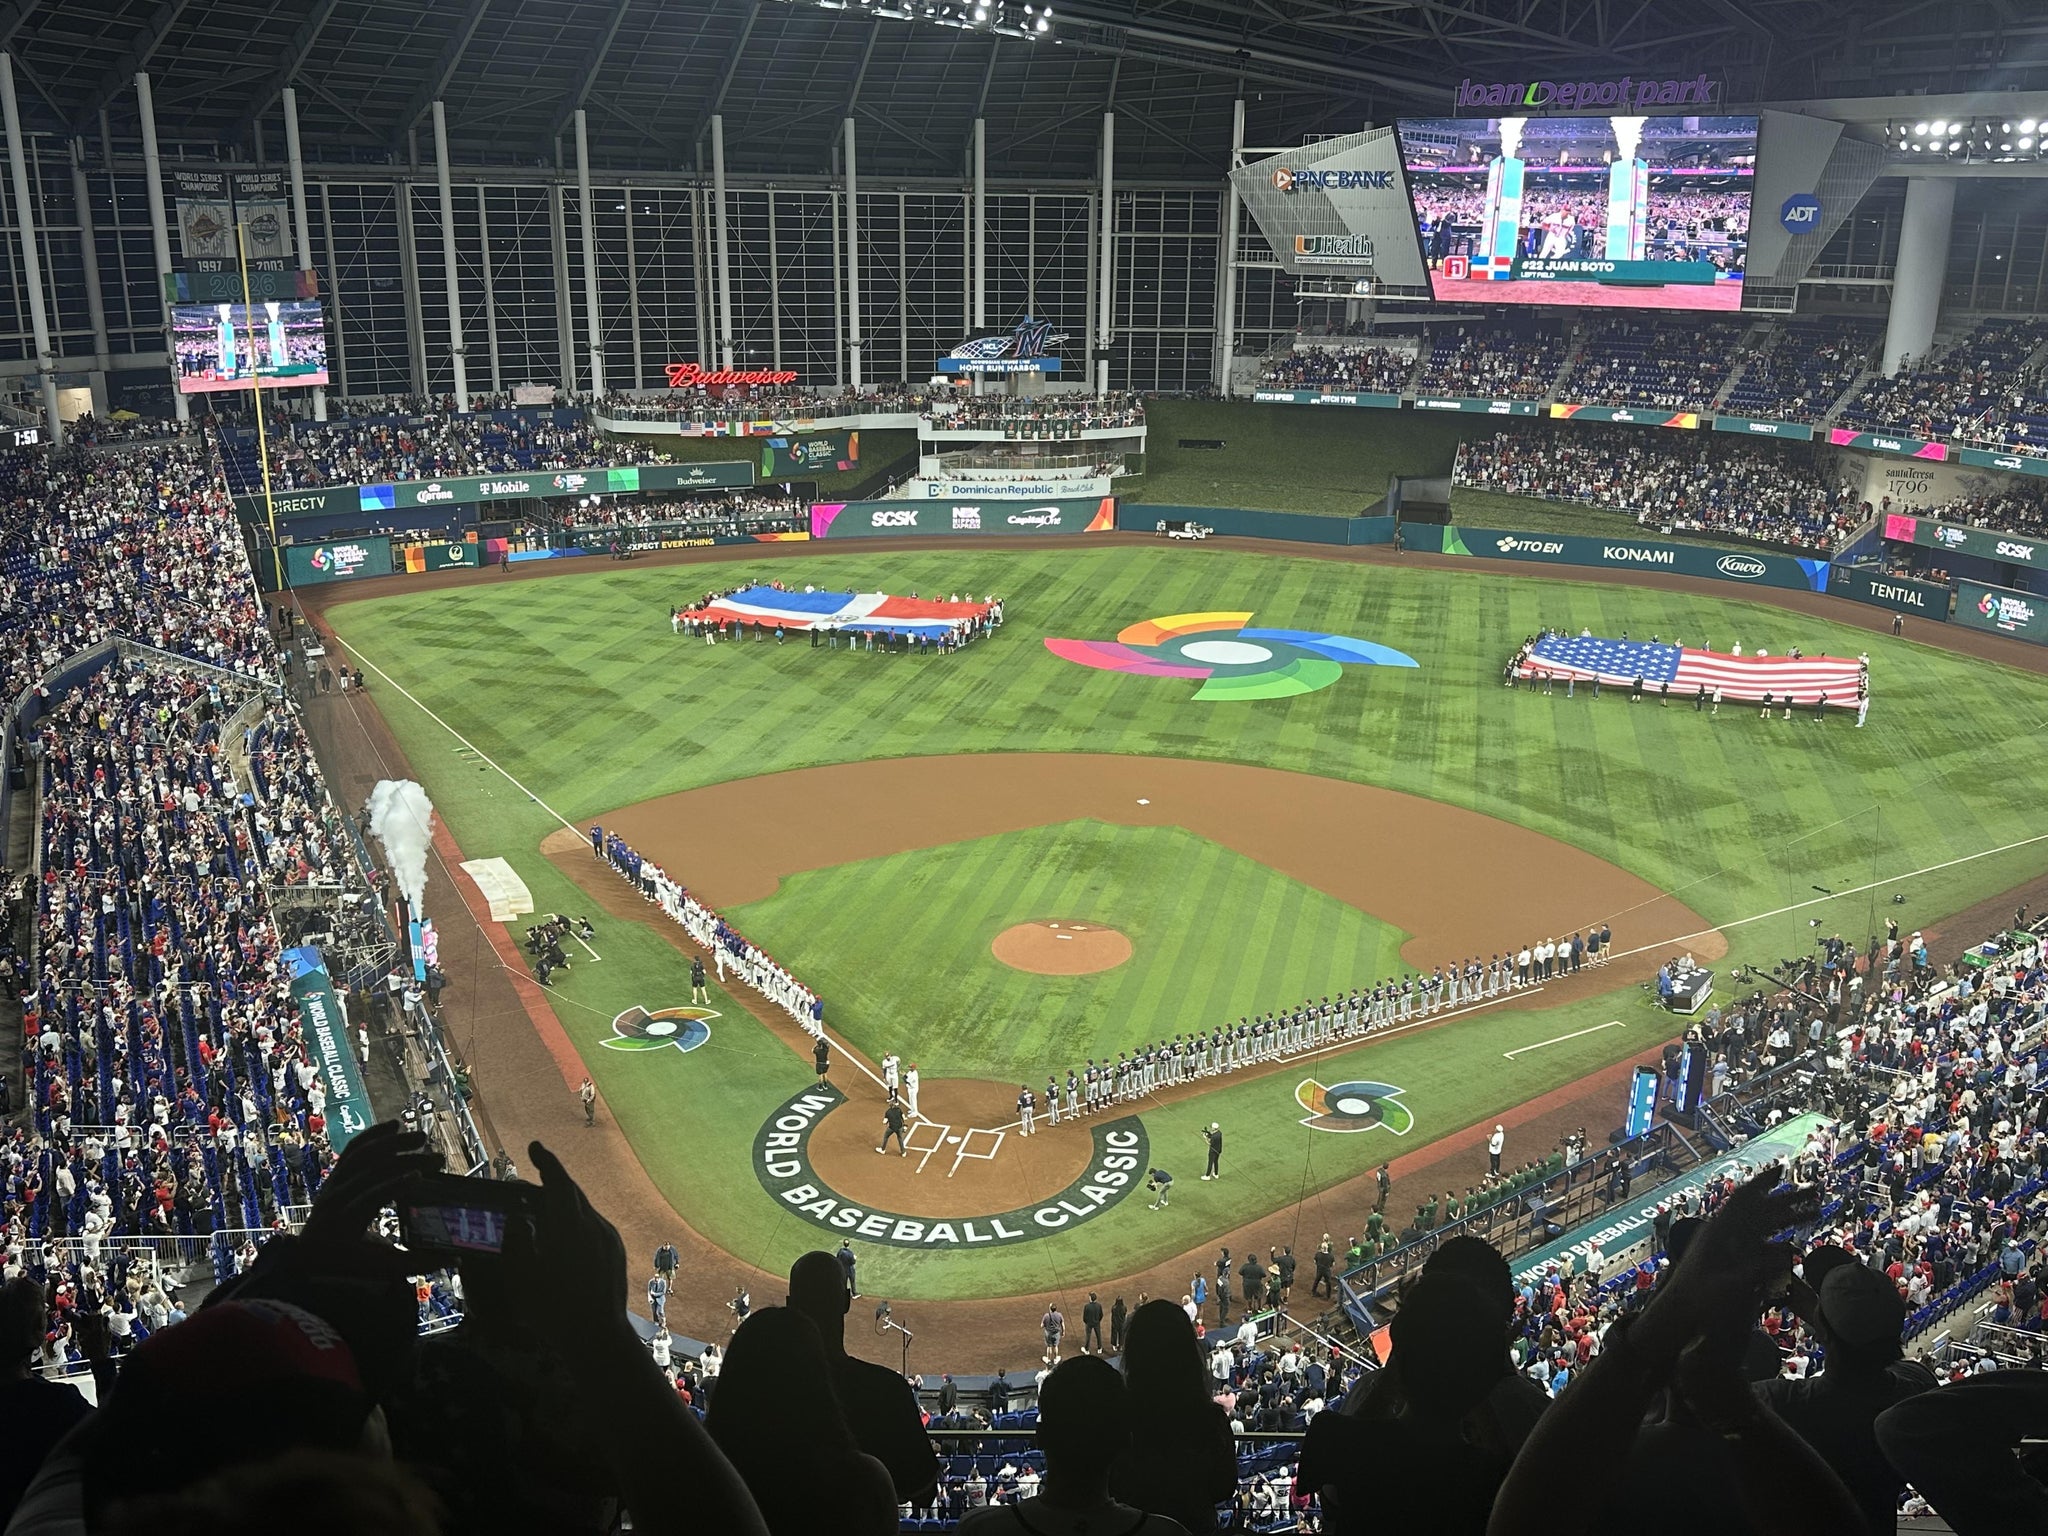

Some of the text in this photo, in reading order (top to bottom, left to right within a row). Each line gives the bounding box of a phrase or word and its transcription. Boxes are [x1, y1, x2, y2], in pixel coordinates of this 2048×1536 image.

[1457, 74, 1717, 111] loanDepot park
[174, 172, 223, 183] WORLD SERIES
[235, 173, 281, 183] WORLD SERIES
[180, 182, 219, 192] CHAMPIONS
[241, 183, 278, 193] CHAMPIONS
[1784, 206, 1818, 222] ADT
[197, 260, 222, 272] 1997
[1521, 261, 1544, 270] #22
[1545, 262, 1579, 271] JUAN
[1580, 262, 1615, 272] SOTO
[209, 275, 276, 297] 2026
[1355, 283, 1369, 293] 42
[665, 363, 798, 387] Budweiser
[959, 364, 1040, 372] HOME RUN HARBOR
[1256, 393, 1274, 401] PITCH
[1321, 395, 1339, 403] PITCH
[1340, 396, 1356, 404] TYPE
[1749, 423, 1778, 433] DIRECTV
[13, 430, 38, 447] 7:50
[808, 440, 828, 448] WORLD
[491, 481, 530, 494] Mobile
[677, 476, 717, 486] Budweiser
[1080, 483, 1095, 493] Club
[1888, 480, 1928, 496] 1796
[416, 488, 453, 503] Corona
[271, 496, 326, 514] DIRECTV
[871, 510, 918, 527] SCSK
[661, 538, 715, 549] EVERYTHING
[1517, 540, 1564, 554] ITO EN
[1995, 541, 2035, 560] SCSK
[1603, 546, 1675, 564] KONAMI
[1720, 557, 1764, 575] Kowa
[1870, 581, 1925, 607] TENTIAL
[308, 1000, 351, 1099] WORLD BASEBALL CLASSIC
[765, 1094, 1139, 1243] WORLD BASEBALL CLASSIC
[1569, 1216, 1648, 1257] BASEBALL
